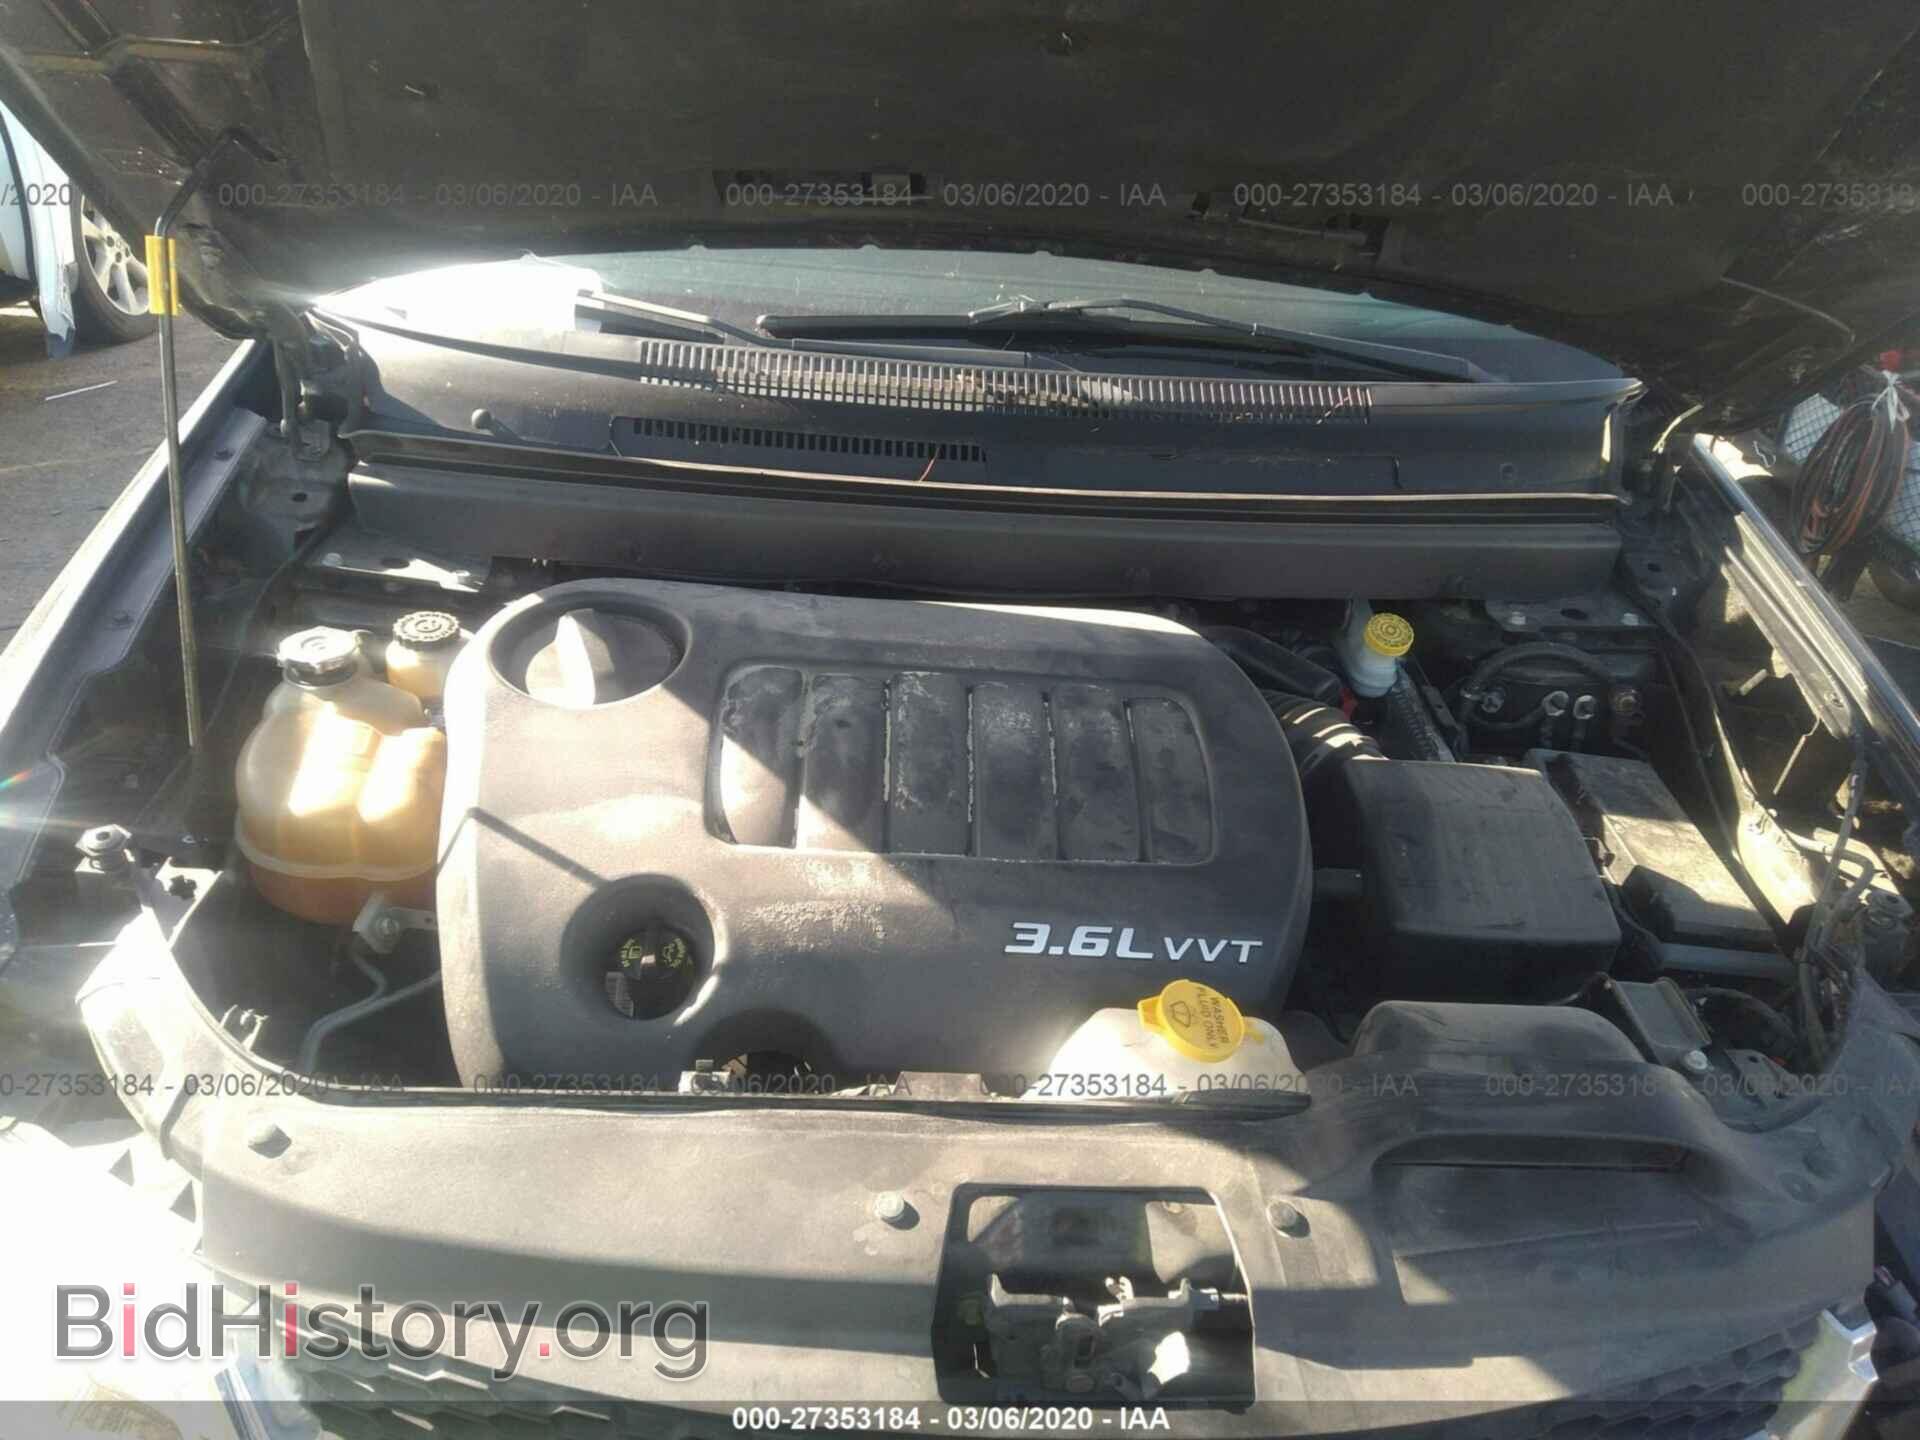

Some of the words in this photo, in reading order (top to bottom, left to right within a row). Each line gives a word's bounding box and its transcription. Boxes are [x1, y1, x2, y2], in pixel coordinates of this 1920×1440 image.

[1003, 922, 1153, 959] 3.6L
[1163, 937, 1262, 963] VVT
[1204, 1021, 1218, 1048] ONLY
[1211, 997, 1229, 1043] WASHER
